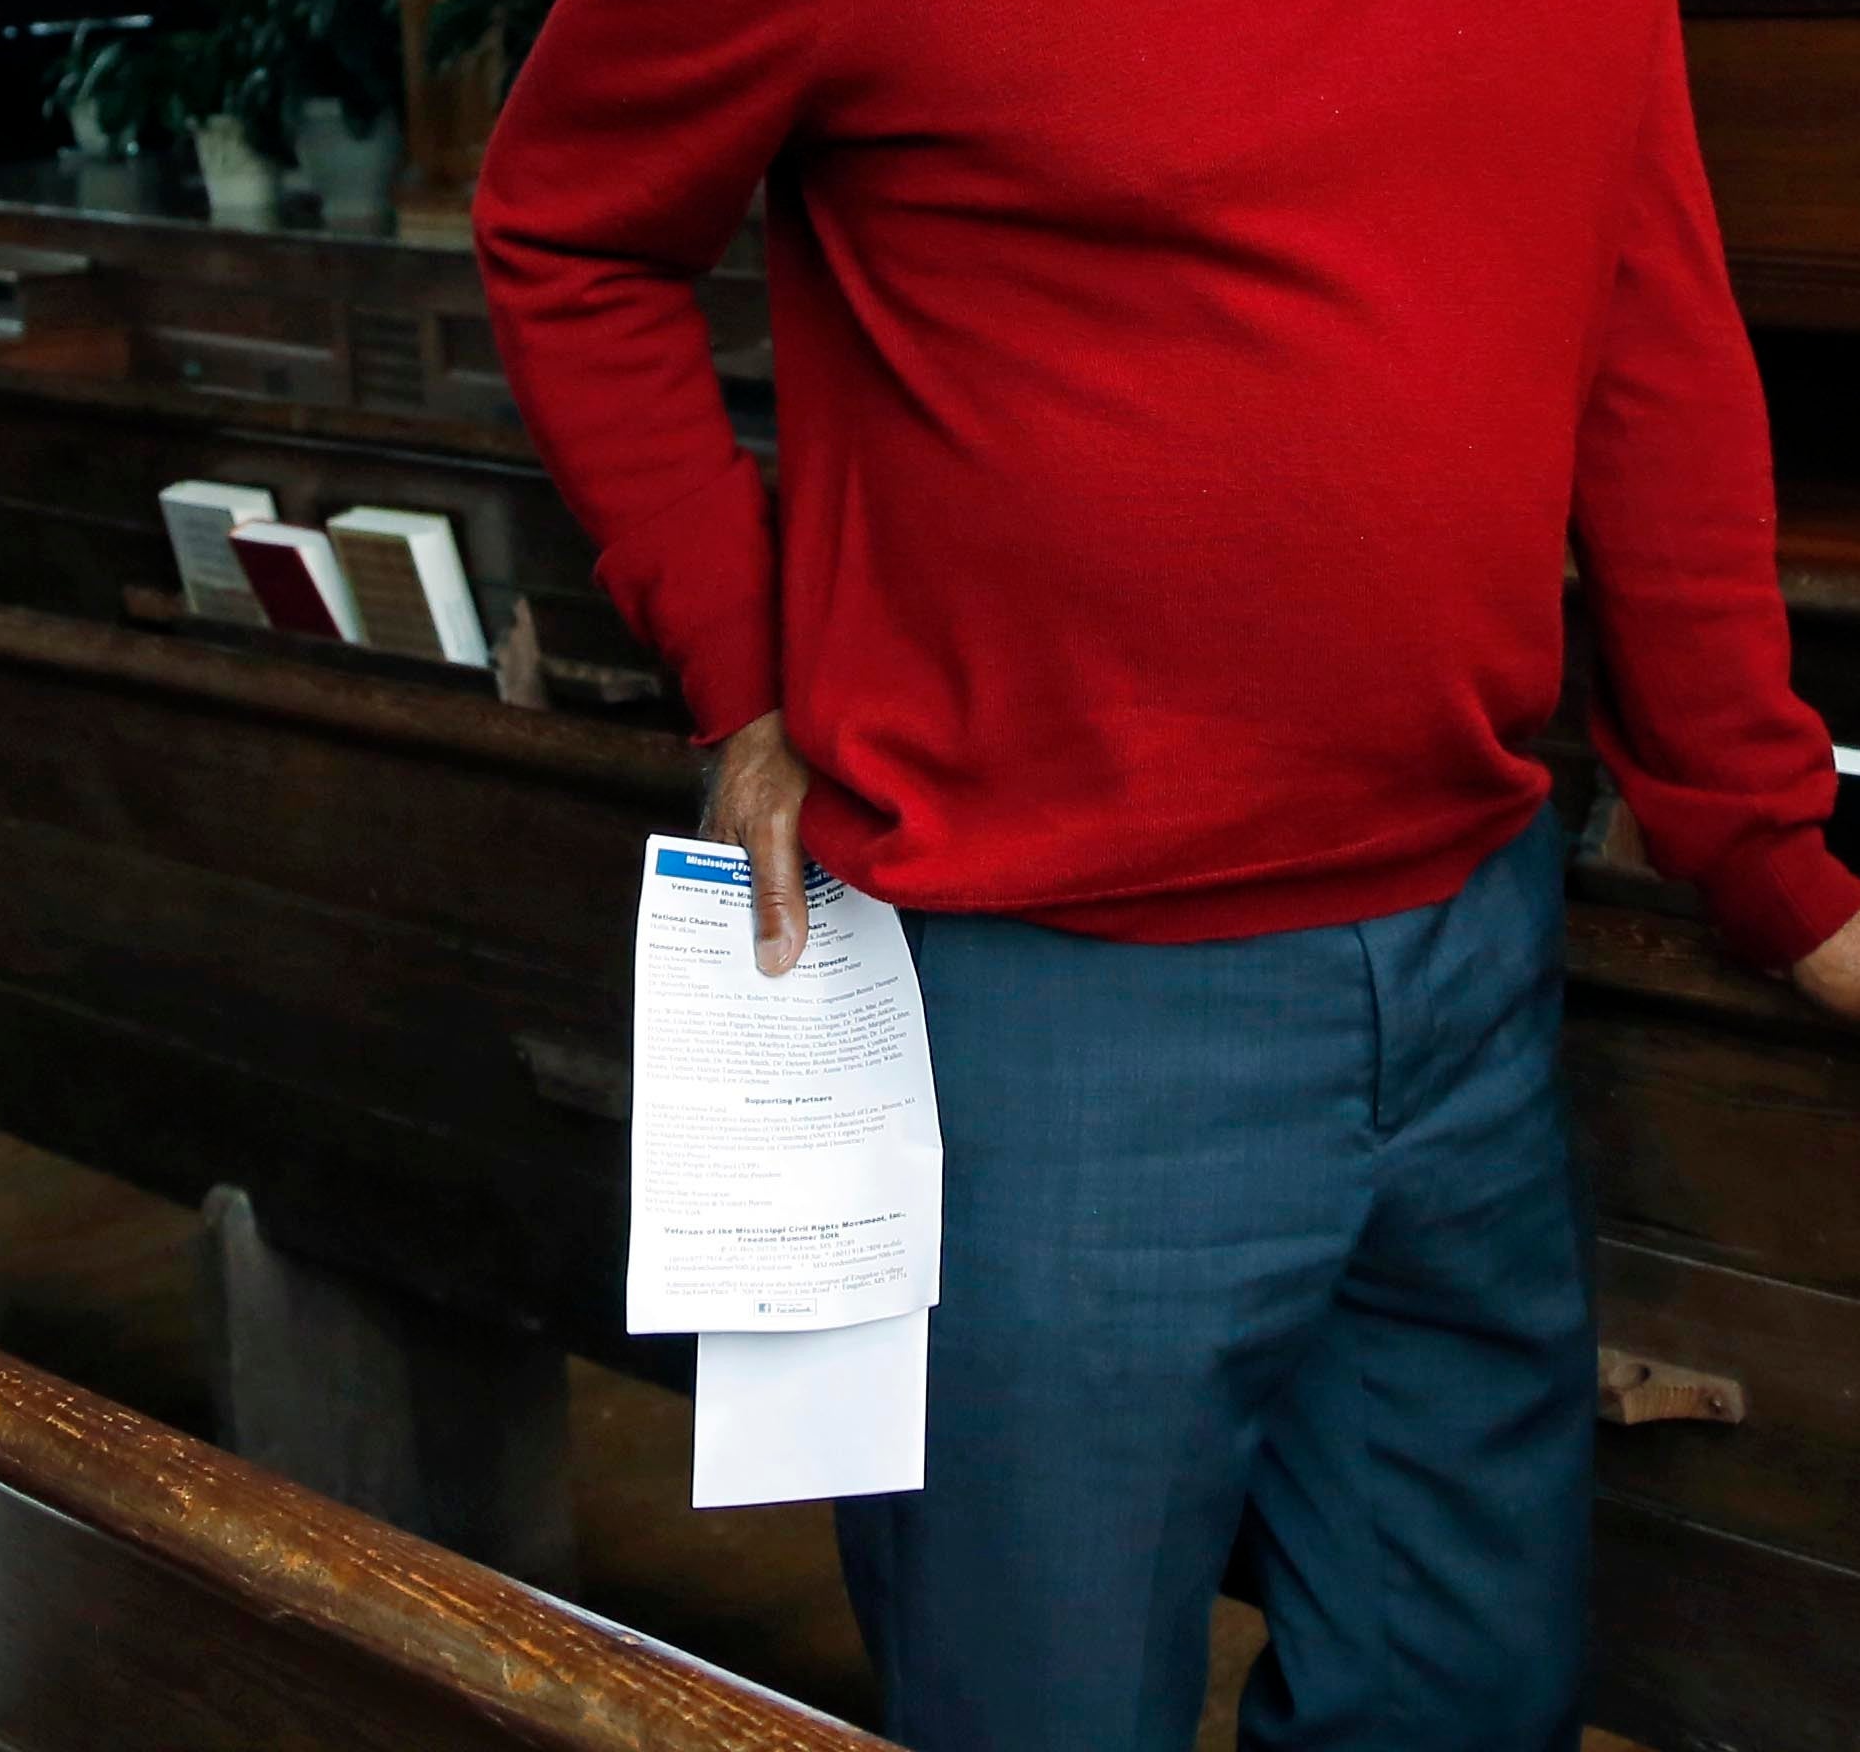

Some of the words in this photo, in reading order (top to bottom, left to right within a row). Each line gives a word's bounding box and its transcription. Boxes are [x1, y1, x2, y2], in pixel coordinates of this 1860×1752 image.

[685, 855, 737, 870] Mississippi
[671, 883, 708, 894] Veterans
[652, 914, 686, 922] National
[689, 918, 728, 928] Chairman
[650, 943, 687, 953] Honorary
[819, 956, 848, 968] Director
[747, 994, 768, 1002] Robert
[744, 1097, 793, 1105] Supporting
[795, 1095, 833, 1103] Partners
[834, 1109, 856, 1118] School
[664, 1227, 703, 1235] Veterans
[811, 1224, 839, 1232] Rights
[842, 1217, 887, 1228] Movement,
[812, 1286, 830, 1294] Road
